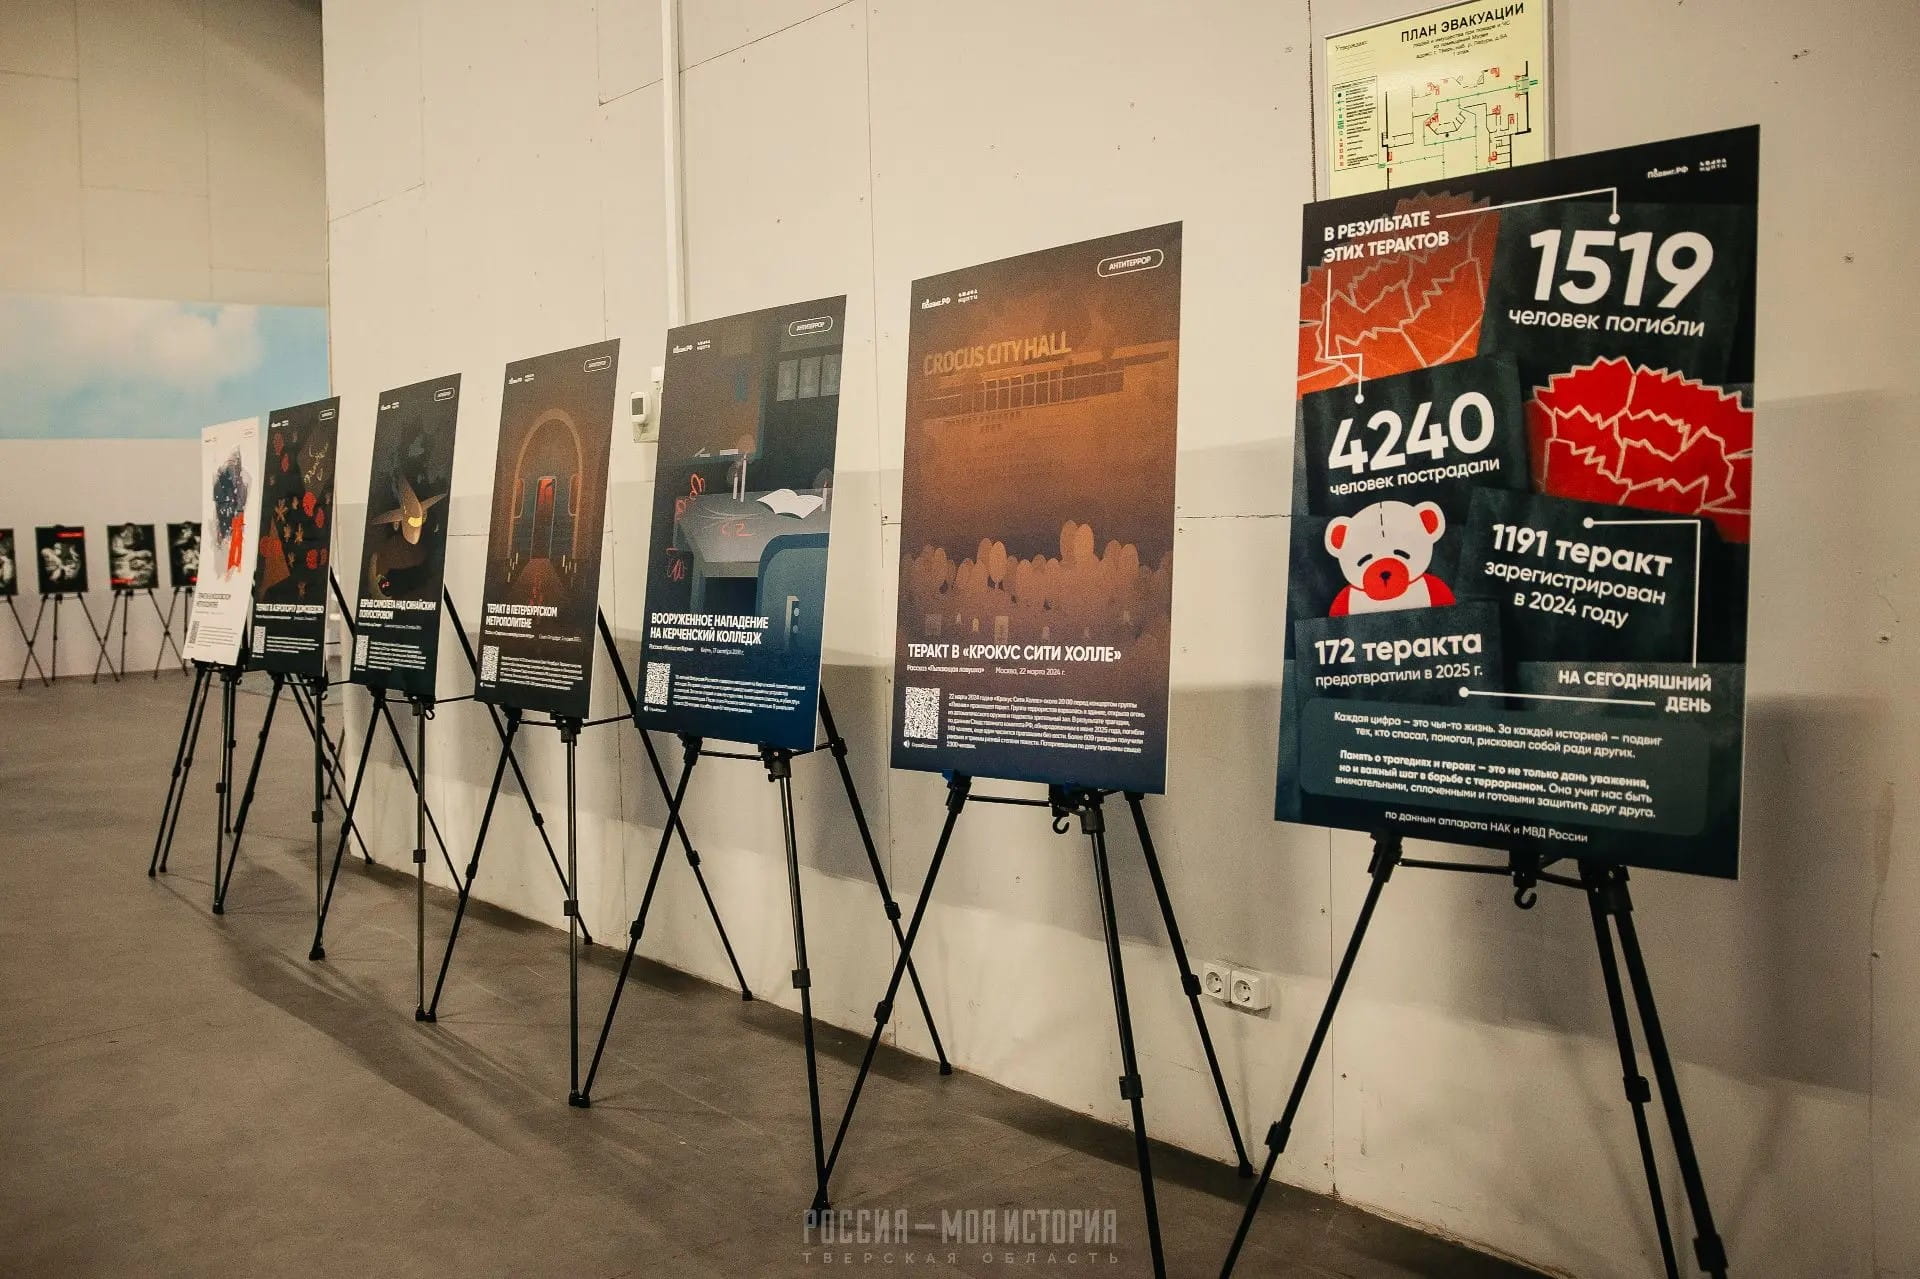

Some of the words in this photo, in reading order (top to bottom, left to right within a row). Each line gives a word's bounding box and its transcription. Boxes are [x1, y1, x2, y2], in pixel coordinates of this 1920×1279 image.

[1402, 24, 1436, 42] ПЛАН
[1442, 2, 1524, 33] ЭВАКУАЦИИ
[1325, 226, 1335, 242] В
[1337, 210, 1430, 239] РЕЗУЛЬТАТЕ
[1324, 244, 1364, 264] ЭТИХ
[1367, 231, 1449, 258] ТЕРАКТОВ
[1530, 229, 1714, 309] 1519
[1508, 307, 1599, 332] человек
[1605, 313, 1705, 338] погибли
[923, 344, 985, 376] CROCUS
[987, 339, 1022, 364] CITY
[1024, 330, 1072, 359] HALL
[1328, 391, 1495, 475] 4240
[1330, 475, 1394, 497] человек
[1397, 456, 1500, 489] пострадали
[1491, 523, 1547, 558] 1191
[1555, 538, 1673, 577] теракт
[1484, 560, 1666, 606] зарегистрирован
[487, 603, 506, 614] ТЕРАКТ
[651, 612, 713, 627] ВООРУЖЕННОЕ
[714, 615, 769, 630] НАПАДЕНИЕ
[1514, 594, 1524, 608] в
[1528, 591, 1577, 616] 2024
[1582, 606, 1629, 630] году
[650, 627, 662, 639] НА
[662, 627, 716, 642] КЕРЧЕНСКИЙ
[716, 629, 762, 646] КОЛЛЕДЖ
[907, 643, 949, 659] ТЕРАКТ
[951, 644, 960, 659] В
[962, 644, 1021, 661] «КРОКУС
[1023, 645, 1061, 662] СИТИ
[1064, 645, 1122, 663] ХОЛЛЕ»
[1314, 637, 1356, 665] 172
[1361, 632, 1482, 665] теракта
[1046, 668, 1061, 676] 2024
[1315, 665, 1421, 688] предотвратили
[1424, 667, 1433, 679] в
[1435, 663, 1471, 680] 2025
[1473, 665, 1483, 677] г.
[1558, 670, 1582, 686] НА
[1583, 670, 1712, 692] СЕГОДНЯШНИЙ
[1665, 695, 1711, 714] ДЕНЬ
[1334, 711, 1369, 724] Каждая
[1371, 715, 1401, 727] цифра
[1413, 719, 1429, 728] это
[1431, 720, 1462, 731] чья-то
[1464, 722, 1496, 733] жизнь.
[1498, 723, 1512, 735] За
[1513, 726, 1553, 738] каждой
[1555, 730, 1608, 742] историей
[1622, 735, 1663, 747] подвиг
[1355, 727, 1372, 738] тех,
[1374, 729, 1391, 738] кто
[1392, 731, 1429, 742] спасал,
[1431, 734, 1475, 747] помогал,
[1477, 737, 1526, 750] рисковал
[1528, 740, 1561, 752] собой
[1563, 743, 1592, 755] ради
[1594, 747, 1636, 759] других.
[1339, 764, 1351, 773] но
[1352, 765, 1359, 773] и
[1360, 766, 1398, 778] важный
[1399, 770, 1419, 780] шаг
[1420, 772, 1426, 780] в
[1427, 771, 1464, 785] борьбе
[1465, 776, 1472, 785] с
[1474, 776, 1547, 793] терроризмом.
[1549, 782, 1572, 795] Она
[1574, 786, 1600, 798] учит
[1601, 791, 1623, 801] нас
[1625, 790, 1653, 804] быть
[1340, 749, 1373, 762] Память
[1374, 755, 1382, 763] о
[1382, 754, 1432, 768] трагедиях
[1433, 760, 1440, 768] и
[1441, 760, 1476, 772] героях
[1488, 764, 1506, 775] это
[1508, 767, 1520, 776] не
[1523, 768, 1559, 779] только
[1560, 771, 1588, 783] дань
[1590, 774, 1650, 790] уважения,
[1335, 776, 1409, 793] внимательными,
[1410, 784, 1477, 799] сплоченными
[1478, 791, 1485, 799] и
[1487, 791, 1535, 805] готовыми
[1537, 797, 1589, 812] защитить
[1590, 802, 1617, 815] друг
[1619, 804, 1656, 819] друга.
[1385, 810, 1397, 820] по
[1399, 812, 1436, 824] данным
[1438, 816, 1488, 831] аппарата
[1490, 822, 1511, 834] НАК
[1513, 826, 1520, 835] и
[1523, 825, 1546, 839] МВД
[1548, 829, 1588, 843] России
